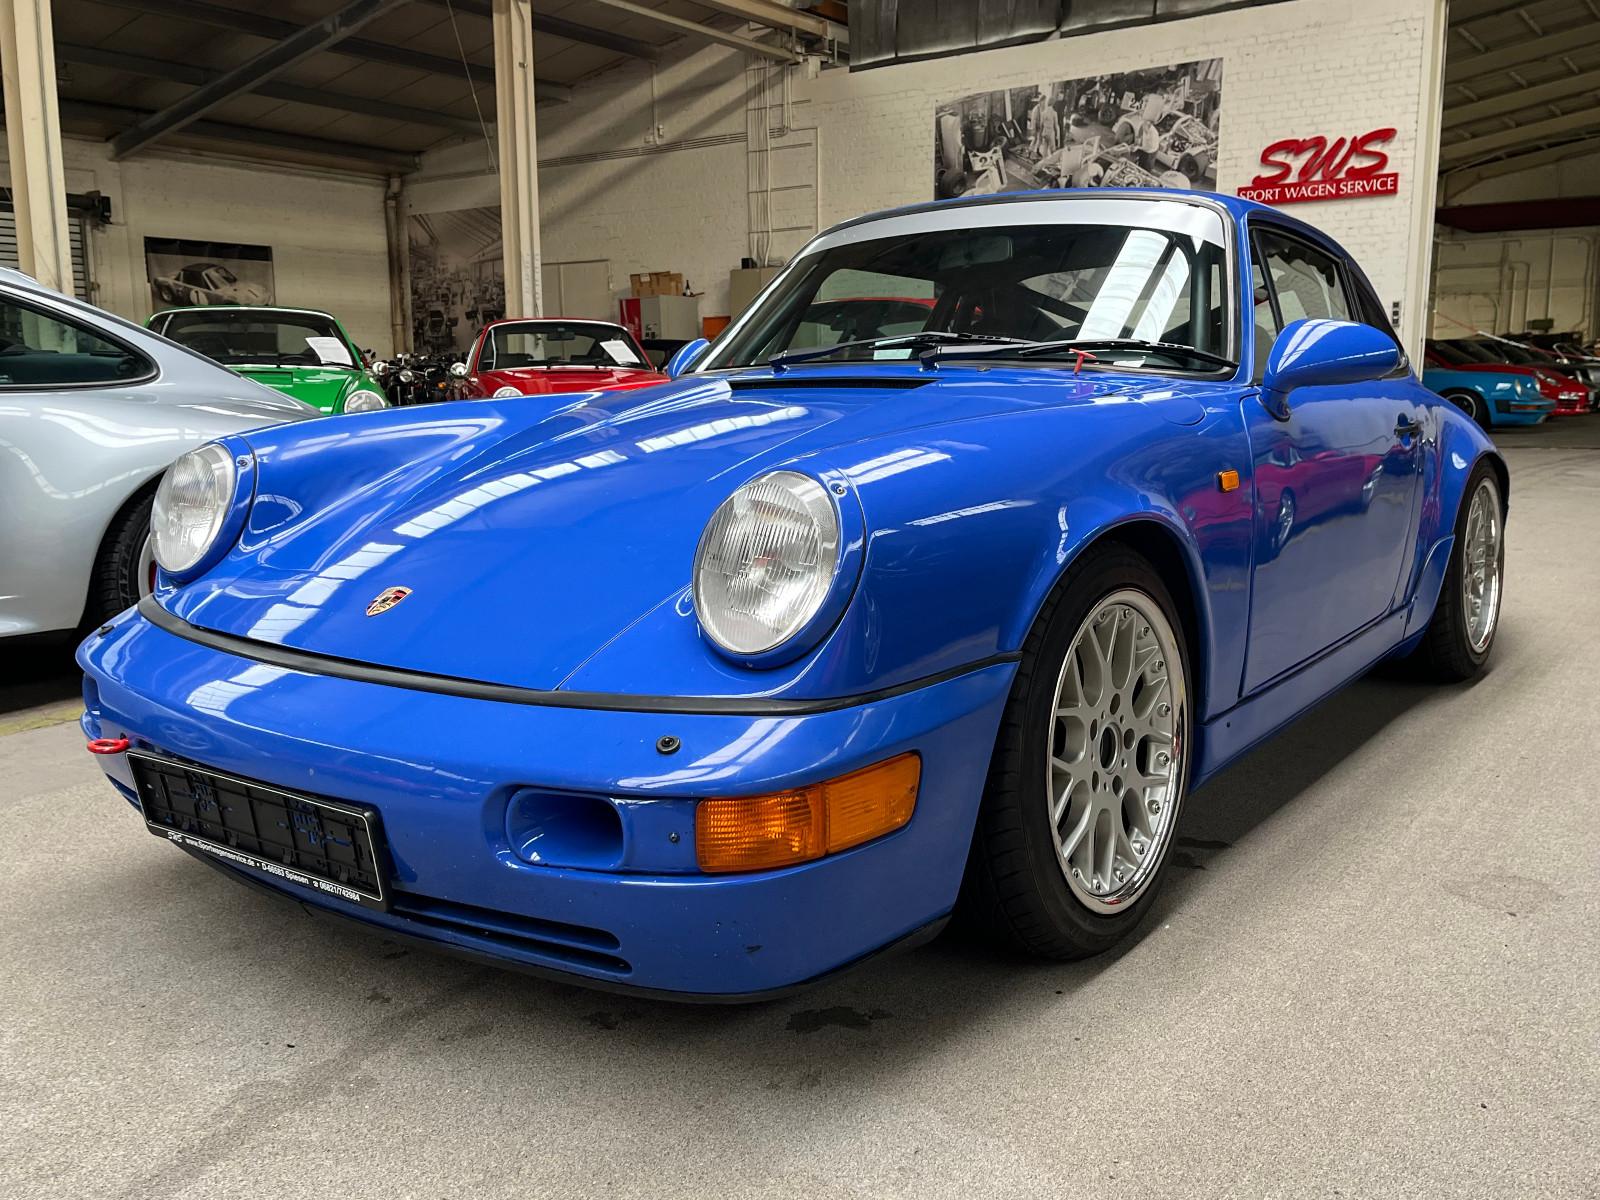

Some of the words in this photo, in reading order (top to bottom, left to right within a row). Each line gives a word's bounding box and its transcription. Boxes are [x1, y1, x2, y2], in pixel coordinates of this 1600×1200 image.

[1252, 128, 1397, 184] SWS
[1239, 188, 1281, 202] SPORT
[1285, 183, 1336, 199] WAGEN
[1339, 177, 1395, 194] SERVICE
[167, 831, 183, 843] SWS
[185, 838, 255, 867] www.Sportwagenservice.de
[285, 870, 310, 885] Spiesen
